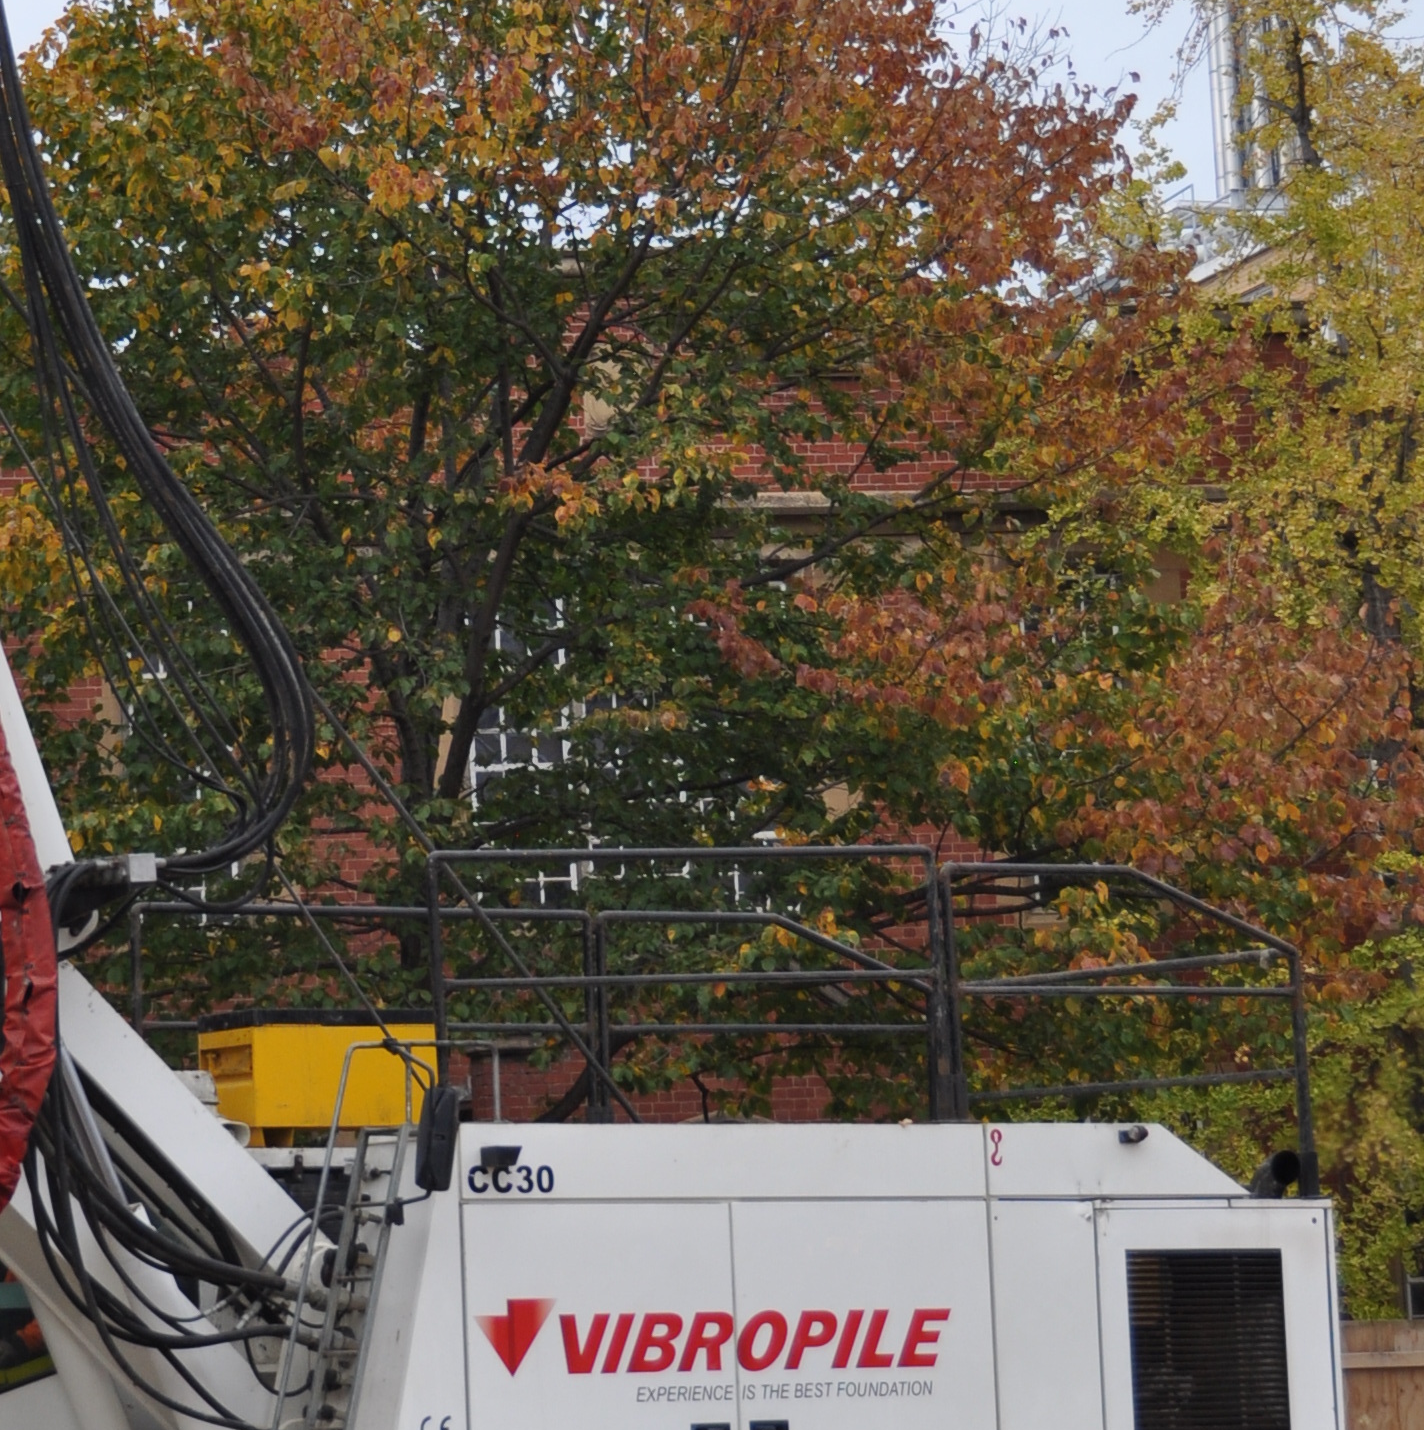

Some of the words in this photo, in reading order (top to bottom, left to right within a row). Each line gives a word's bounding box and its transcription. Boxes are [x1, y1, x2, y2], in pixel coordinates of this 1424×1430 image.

[467, 1164, 555, 1194] CC30
[558, 1308, 952, 1375] VIBROPILE
[636, 1385, 733, 1403] EXPERIENCE
[742, 1384, 756, 1400] IS
[761, 1383, 790, 1400] THE
[794, 1382, 833, 1399] BEST
[836, 1380, 933, 1398] FOUNDATION
